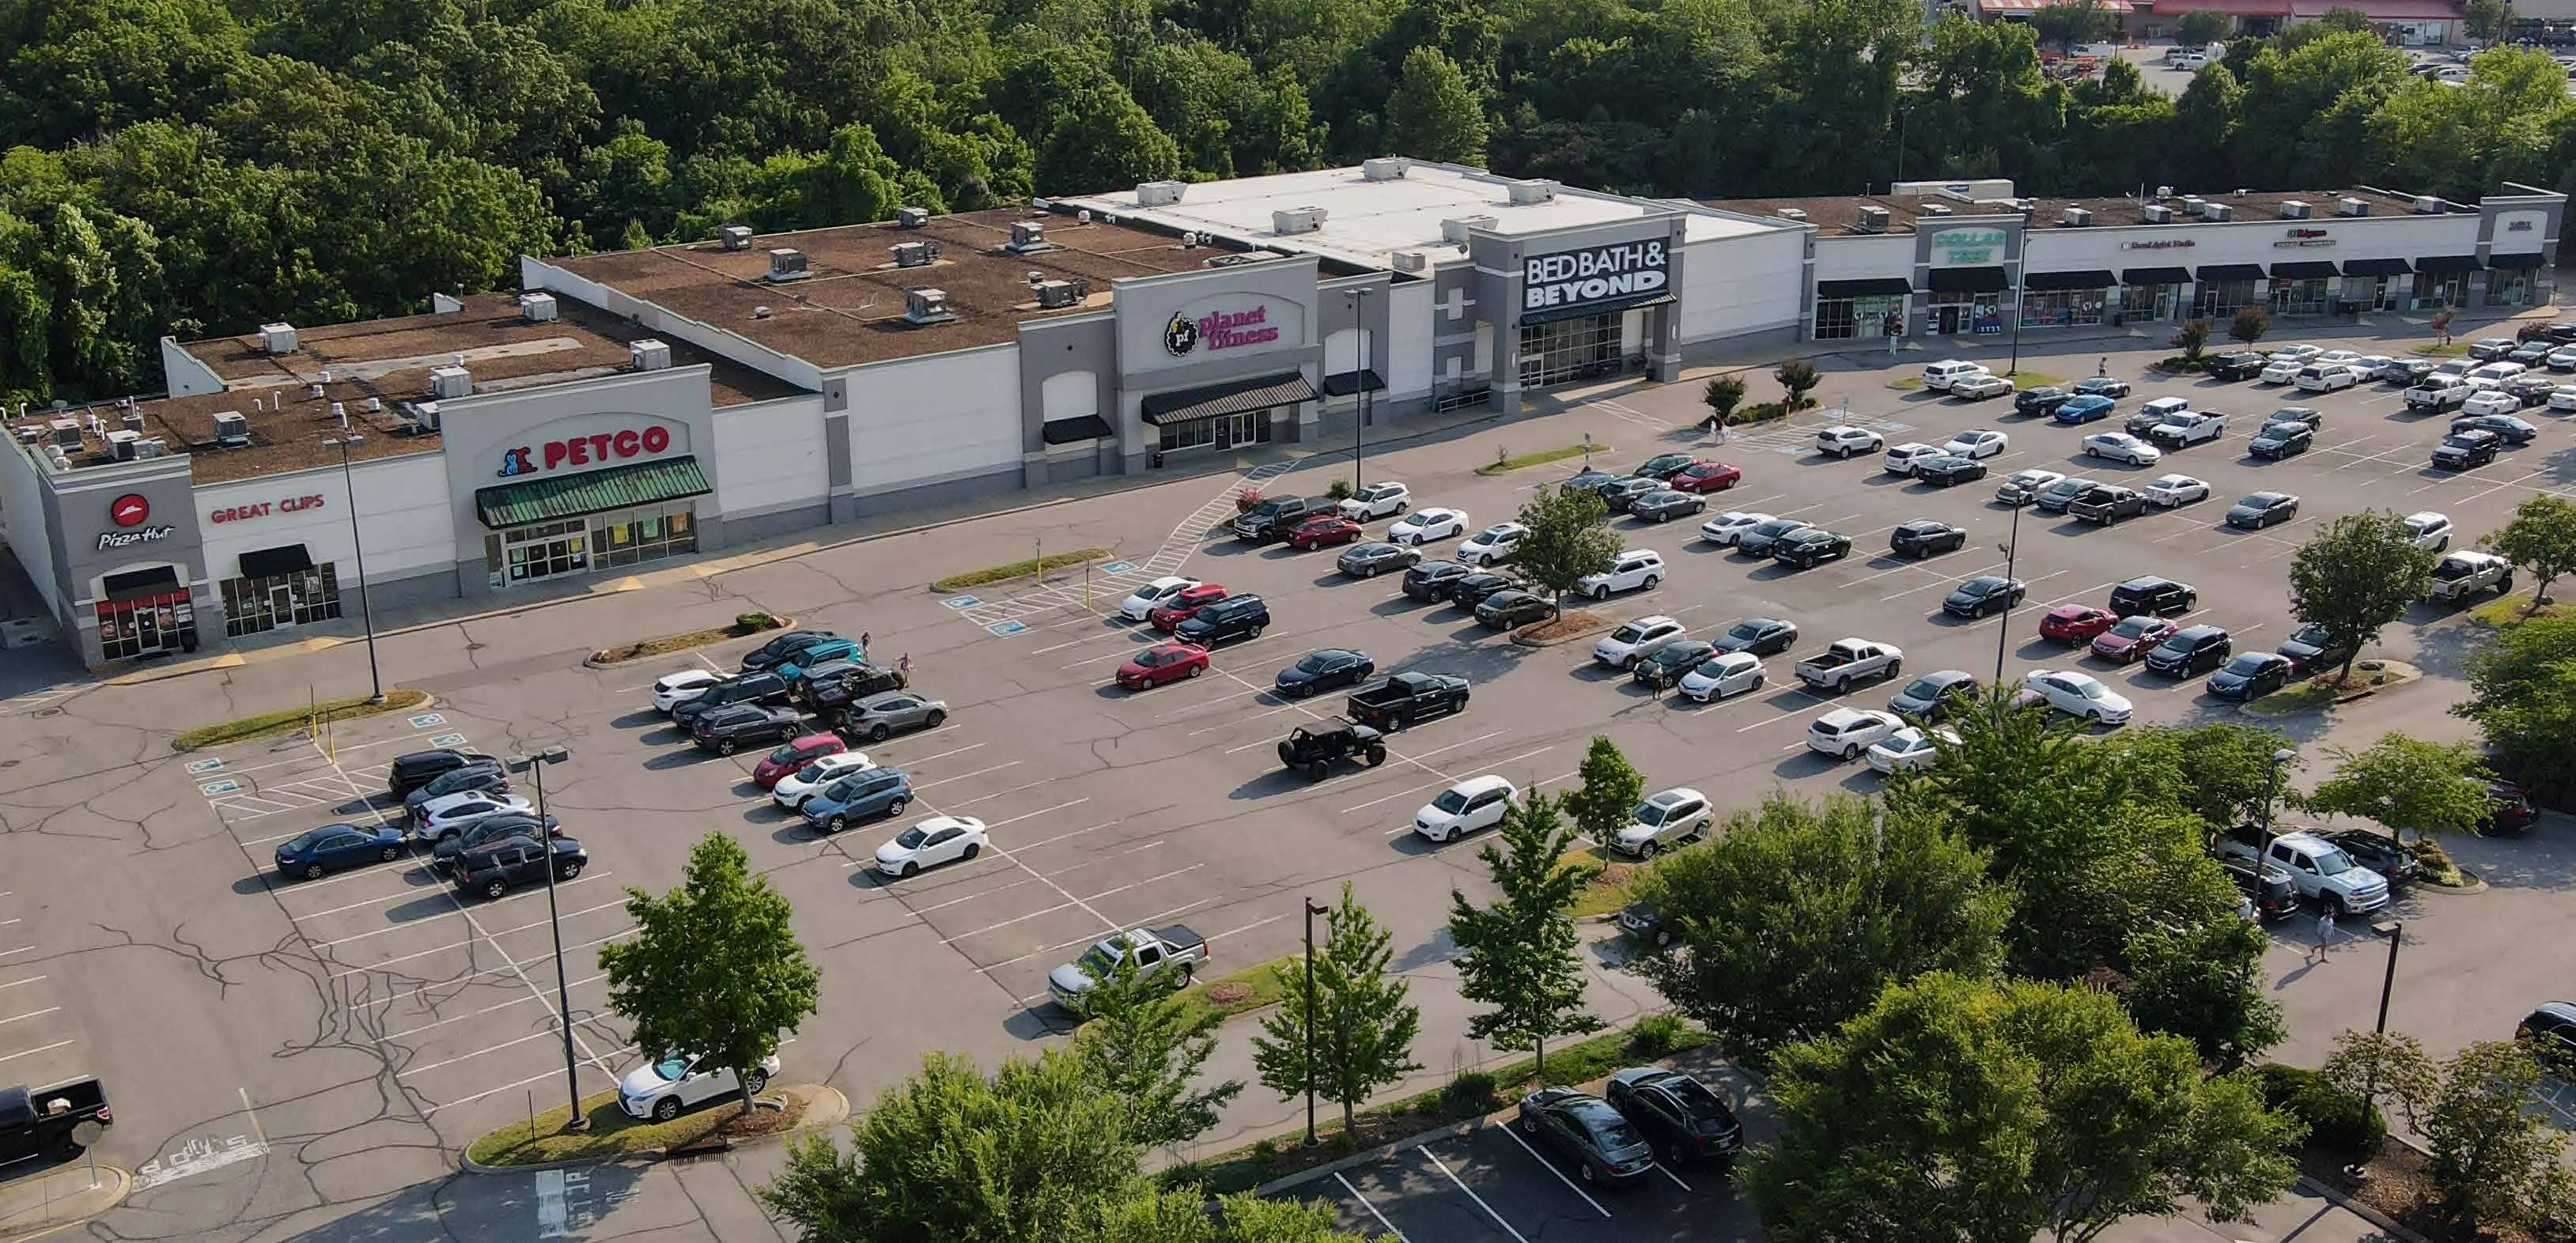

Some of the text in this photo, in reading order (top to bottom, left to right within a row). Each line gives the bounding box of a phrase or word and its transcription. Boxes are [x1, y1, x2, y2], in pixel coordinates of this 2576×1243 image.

[1526, 241, 1666, 285] BED BATH &
[1526, 270, 1666, 308] BEYOND
[1175, 330, 1189, 346] pf
[1198, 305, 1266, 338] planet
[1209, 326, 1279, 350] fitness
[544, 425, 670, 470] PETCO
[211, 493, 325, 523] GREAT CLIPS
